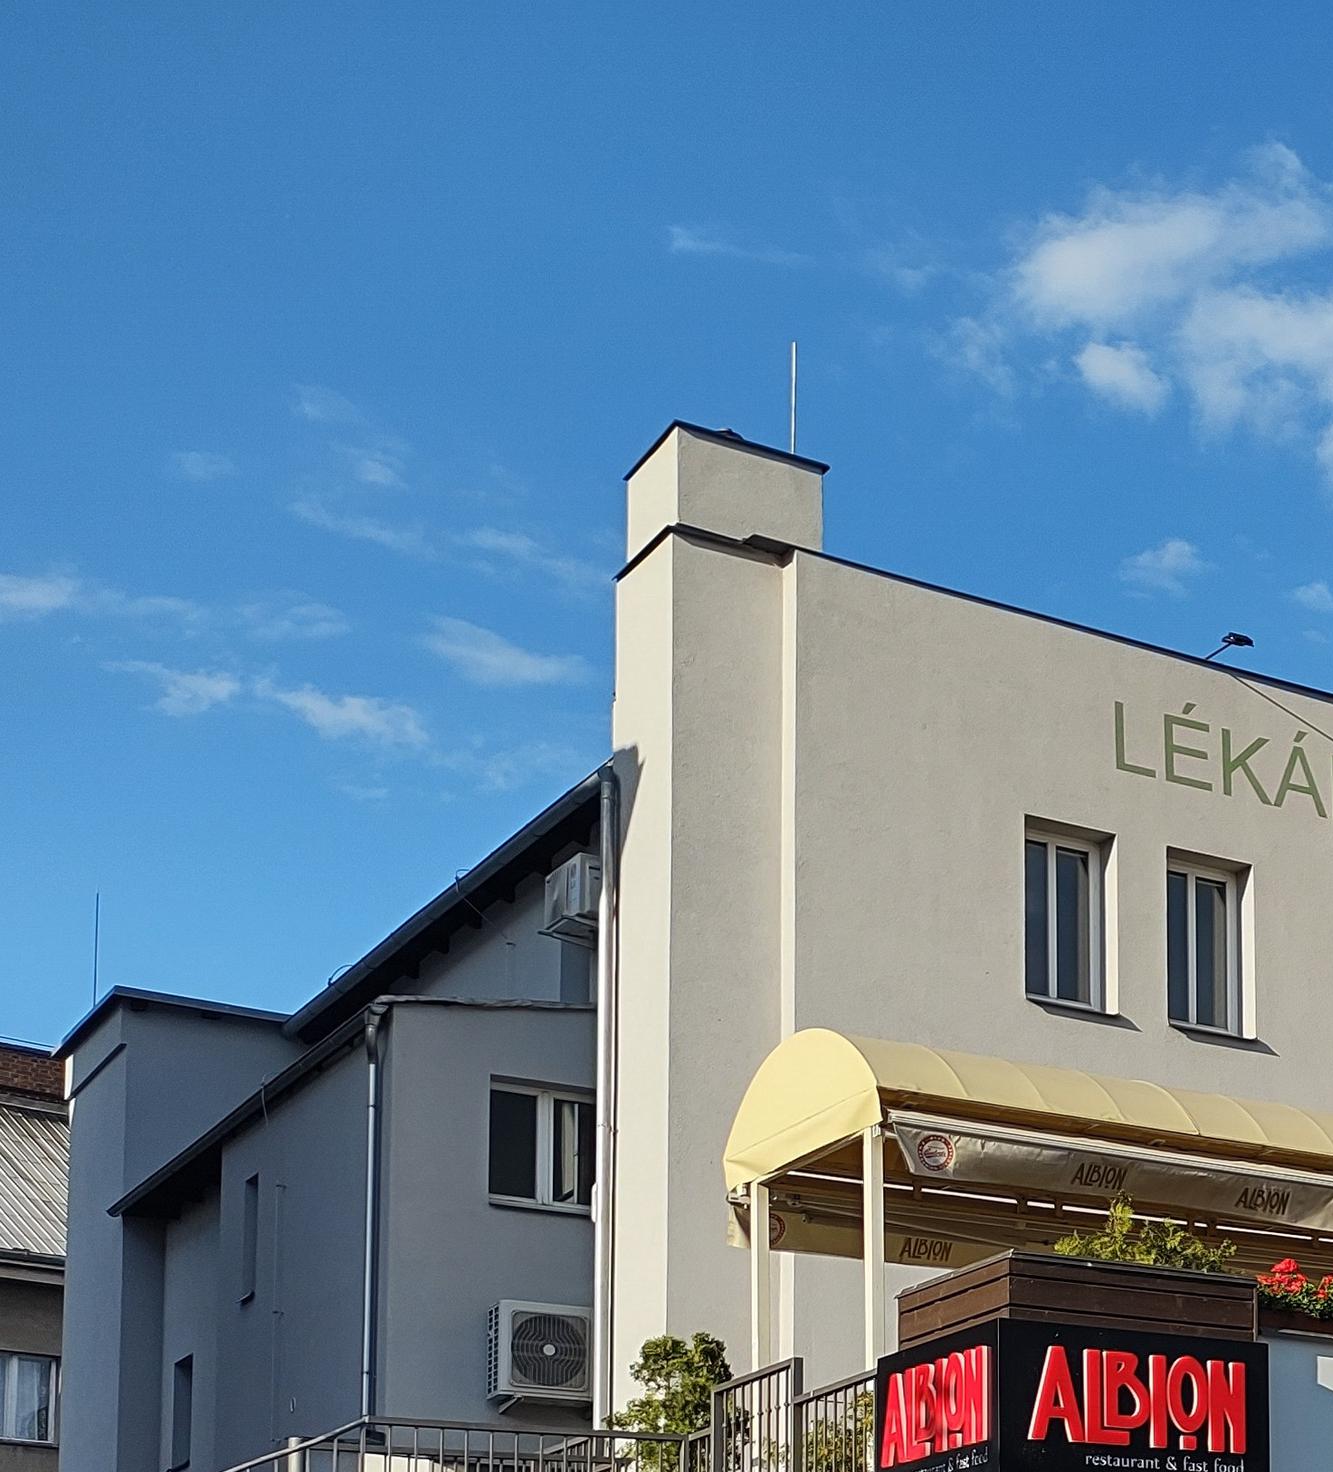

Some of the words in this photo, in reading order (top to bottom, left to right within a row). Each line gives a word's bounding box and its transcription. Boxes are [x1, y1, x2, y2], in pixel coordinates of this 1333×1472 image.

[1071, 1162, 1128, 1190] ALBION
[1234, 1186, 1291, 1216] ALBION
[899, 1236, 953, 1263] ALBION
[880, 1345, 993, 1469] ALBION
[1027, 1344, 1246, 1455] ALBION
[970, 1447, 989, 1466] food
[1084, 1453, 1161, 1470] restaurant
[1166, 1457, 1178, 1471] &
